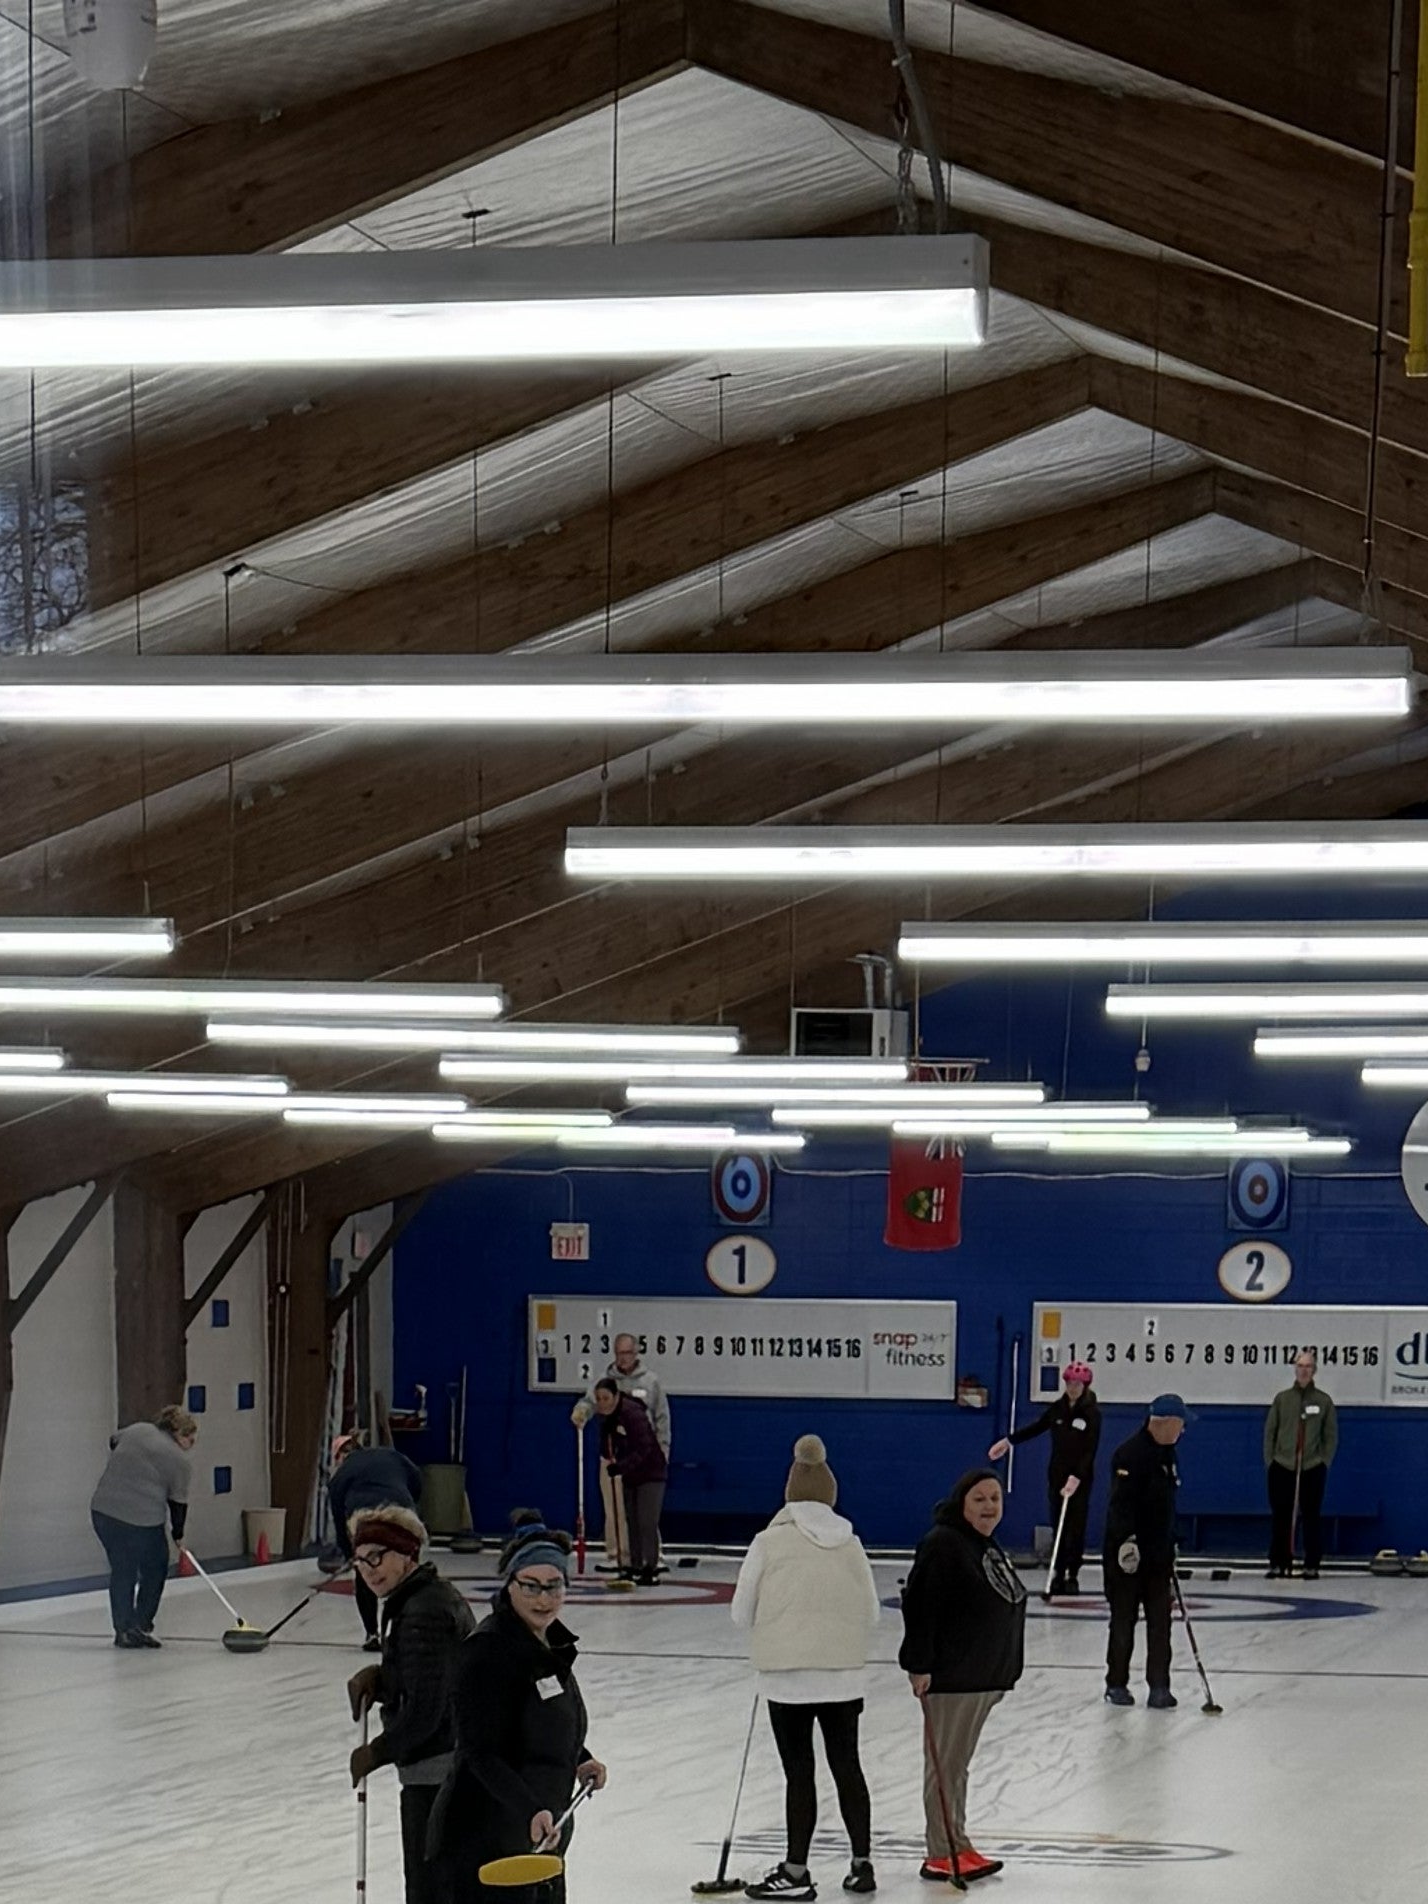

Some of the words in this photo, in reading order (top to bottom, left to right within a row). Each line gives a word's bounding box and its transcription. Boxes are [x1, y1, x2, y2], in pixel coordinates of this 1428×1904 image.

[556, 1235, 584, 1257] EXIT
[732, 1244, 747, 1284] 1
[1244, 1250, 1266, 1292] 2
[581, 1333, 591, 1354] 2
[600, 1333, 610, 1355] 3
[656, 1335, 667, 1355] 6
[675, 1335, 685, 1356] 7
[694, 1335, 705, 1356] 8
[713, 1335, 724, 1357] 9
[729, 1336, 746, 1357] 10
[750, 1337, 764, 1357] 11
[768, 1337, 784, 1357] 12
[787, 1337, 803, 1358] 13
[806, 1337, 823, 1358] 14
[825, 1338, 842, 1358] 15
[844, 1338, 861, 1359] 16
[872, 1331, 919, 1350] snap
[885, 1346, 946, 1367] fitness
[1086, 1342, 1097, 1363] 2
[1106, 1342, 1116, 1363] 3
[1125, 1342, 1136, 1363] 4
[1145, 1343, 1155, 1363] 5
[1164, 1343, 1175, 1364] 6
[1185, 1343, 1195, 1364] 7
[1204, 1343, 1215, 1365] 8
[1224, 1343, 1235, 1365] 9
[1242, 1344, 1259, 1365] 10
[1263, 1345, 1278, 1365] 11
[1322, 1345, 1338, 1366] 14
[1342, 1345, 1359, 1366] 15
[1362, 1345, 1379, 1367] 16
